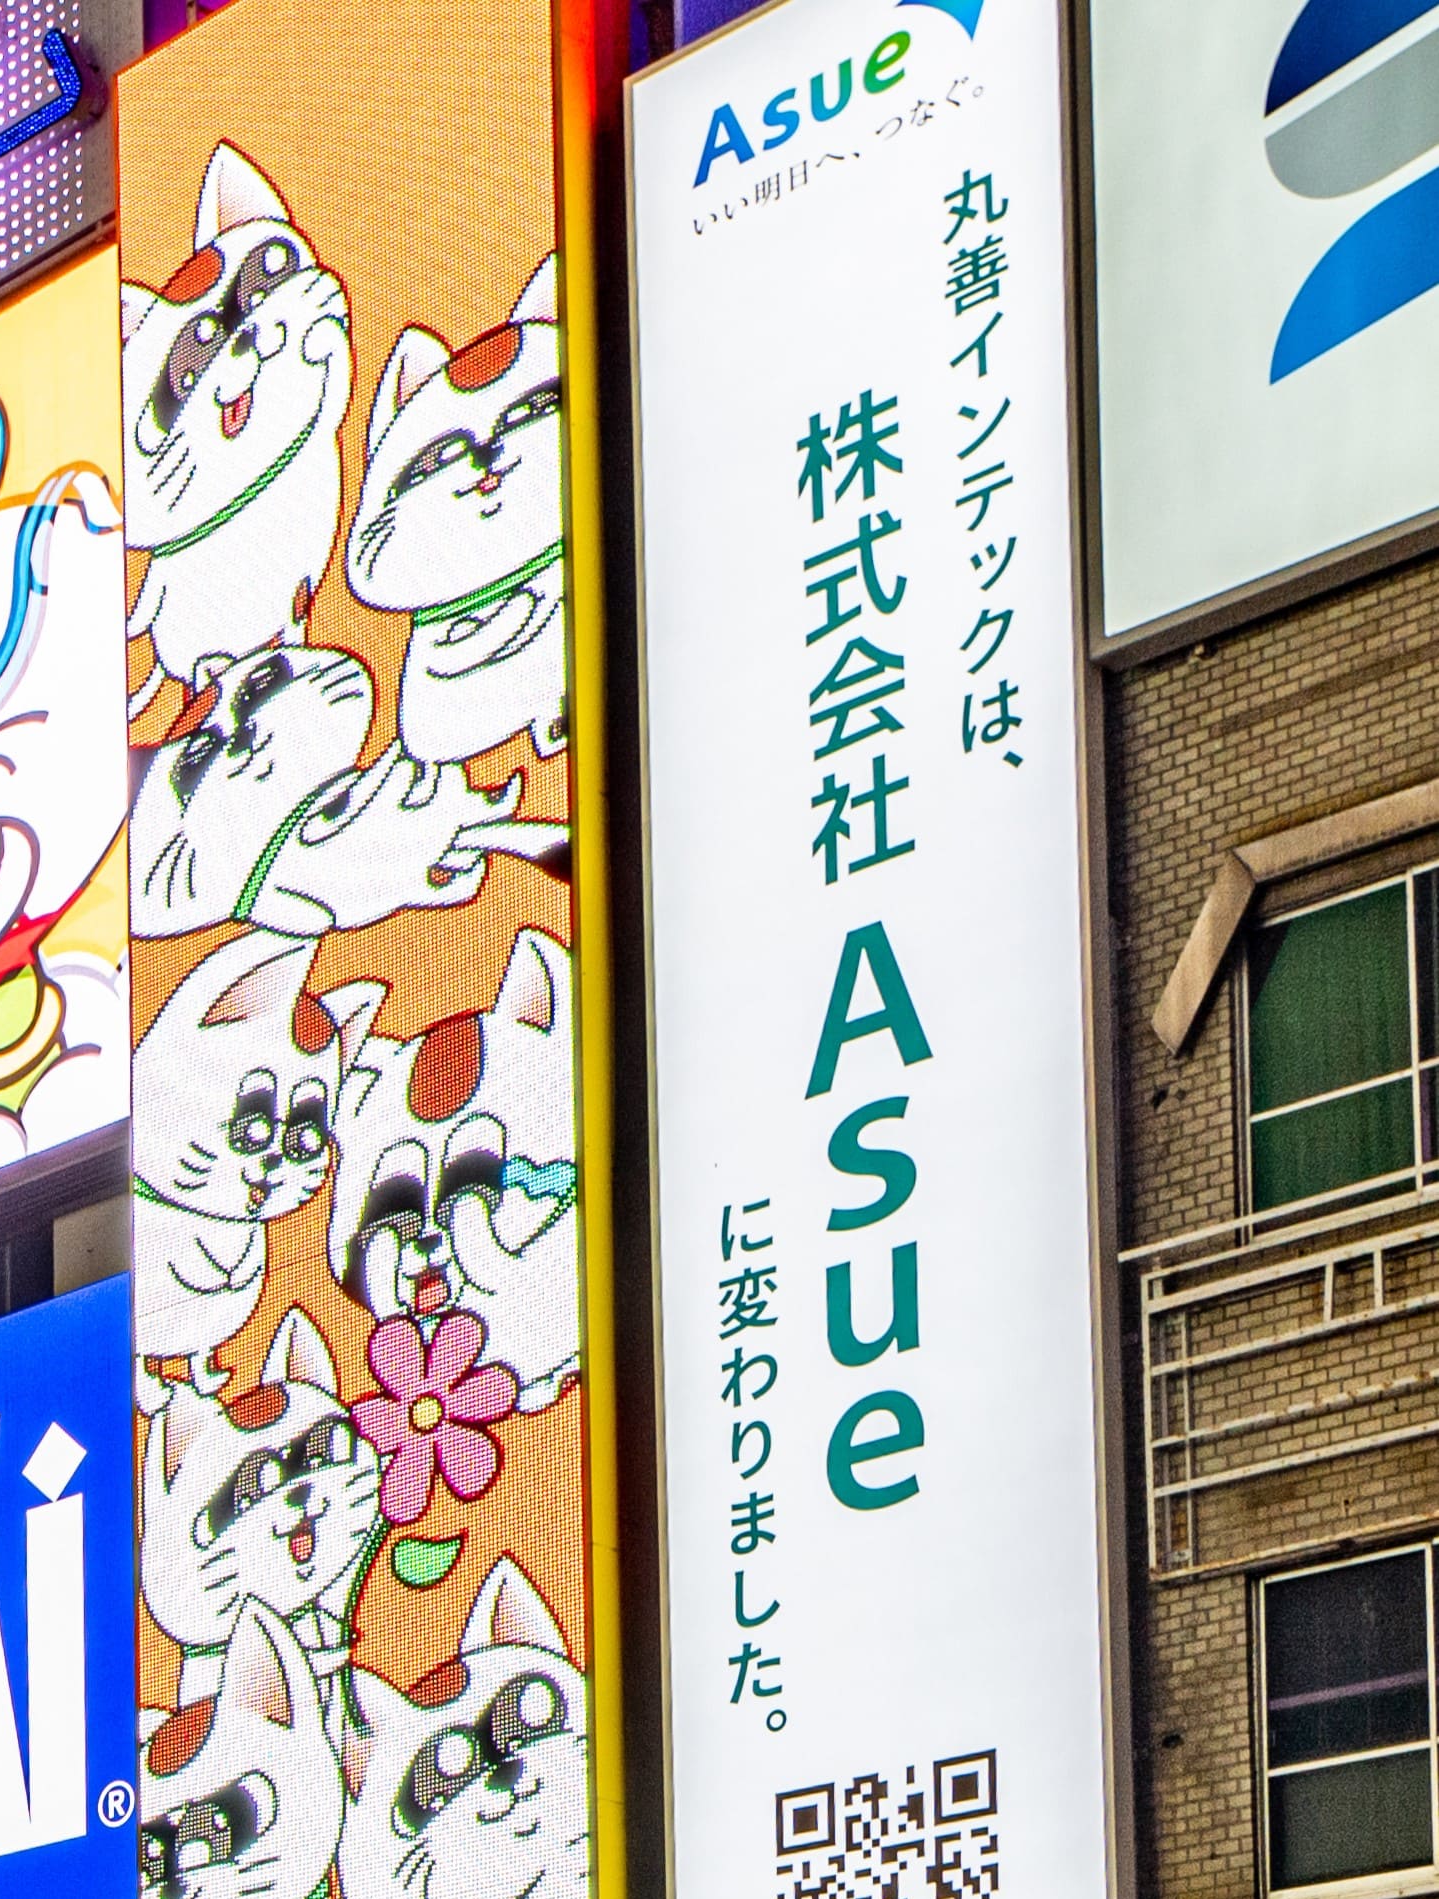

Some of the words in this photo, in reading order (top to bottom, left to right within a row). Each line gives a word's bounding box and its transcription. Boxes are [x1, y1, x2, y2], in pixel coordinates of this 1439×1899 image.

[691, 29, 912, 189] Asue
[796, 388, 916, 886] 株式会社
[941, 168, 1024, 768] 丸善インテックは、
[717, 1197, 788, 1733] に変わりました。
[804, 920, 934, 1512] Asue
